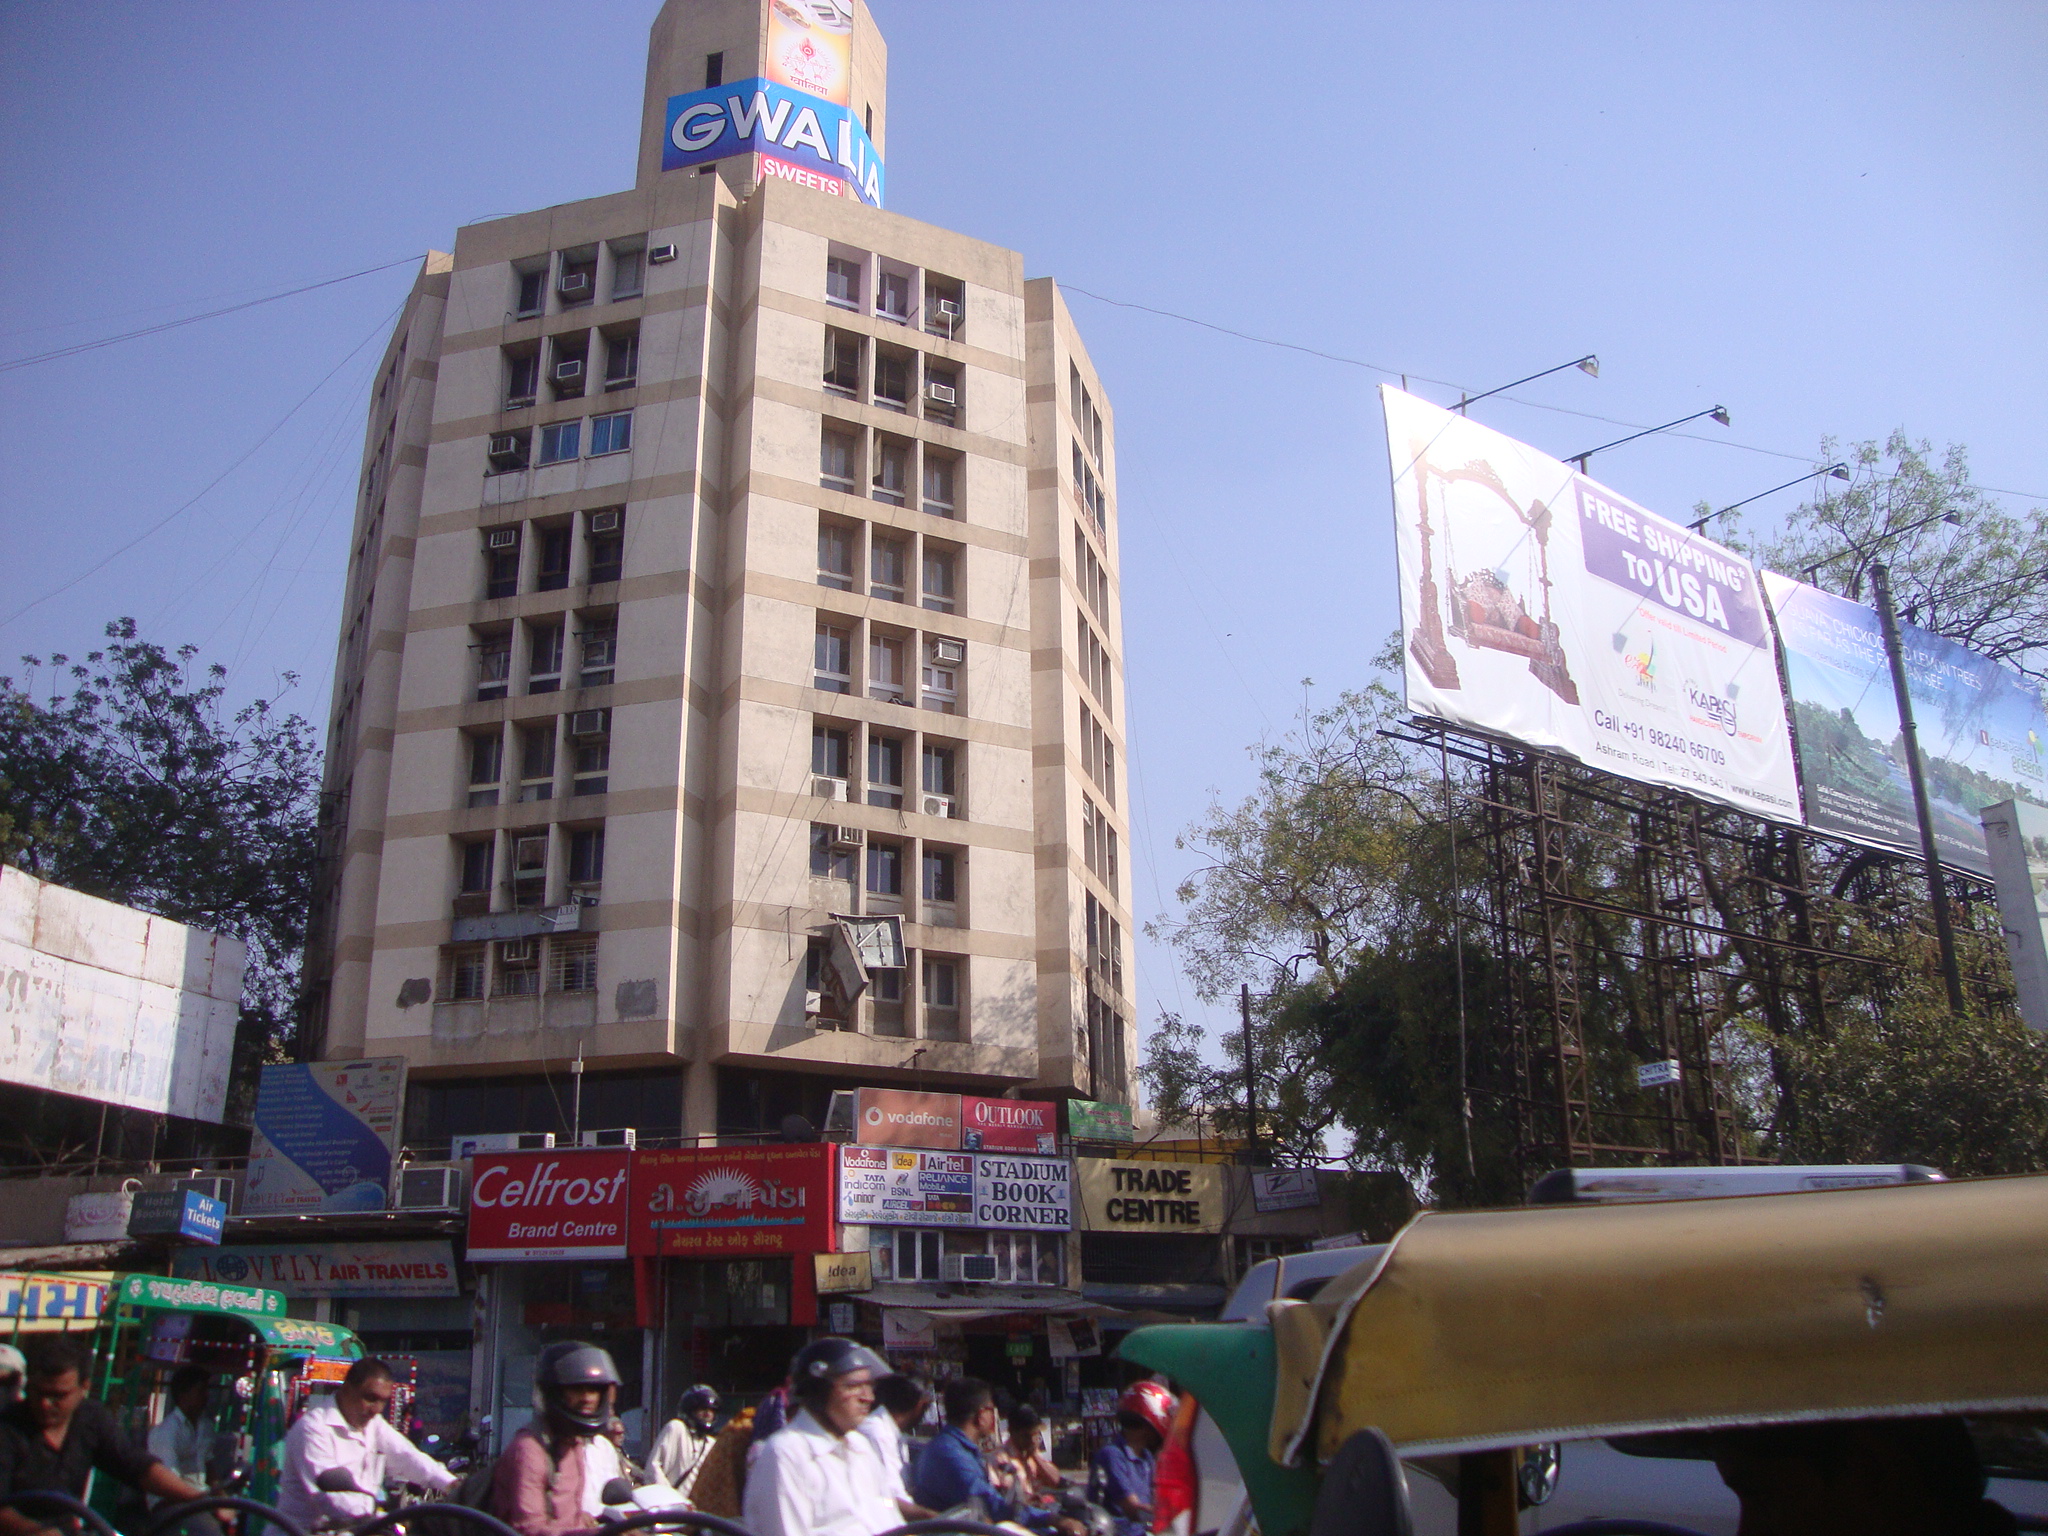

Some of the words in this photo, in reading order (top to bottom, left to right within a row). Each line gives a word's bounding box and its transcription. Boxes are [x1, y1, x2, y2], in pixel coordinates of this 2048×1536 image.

[671, 90, 882, 209] GWALIA
[763, 158, 841, 196] SWEETS
[1583, 491, 1641, 544] FREE
[1622, 549, 1654, 588] TO
[1655, 558, 1730, 631] USA
[1836, 636, 1851, 654] AS
[1851, 641, 1877, 665] THE
[1951, 664, 1983, 691] TREES
[1689, 687, 1737, 728] KAPASI
[1594, 709, 1621, 734] Call
[1622, 721, 1646, 742] +91
[1649, 728, 1687, 755] 98240
[1689, 741, 1727, 767] 66709
[1595, 740, 1631, 762] Ashram
[1631, 752, 1656, 770] Road
[1730, 784, 1794, 809] www.kapasi.com
[886, 1111, 955, 1128] vodafone
[843, 1156, 887, 1169] Vodafone
[927, 1156, 965, 1171] Airtel
[979, 1160, 1069, 1182] STADIUM
[472, 1161, 627, 1209] Celfrost
[843, 1179, 887, 1191] indicom
[863, 1173, 886, 1182] TATA
[1110, 1166, 1193, 1194] TRADE
[853, 1192, 876, 1204] uninor
[890, 1186, 914, 1197] BSNL
[991, 1181, 1058, 1205] BOOK
[198, 1197, 214, 1212] Air
[883, 1199, 910, 1210] AIRCEL
[978, 1204, 1070, 1226] CORNER
[1105, 1197, 1201, 1225] CENTRE
[187, 1208, 221, 1230] Tickets
[507, 1221, 559, 1239] Brand
[562, 1220, 618, 1237] Centre
[328, 1263, 361, 1280] AIR
[363, 1262, 449, 1279] TRAVELS
